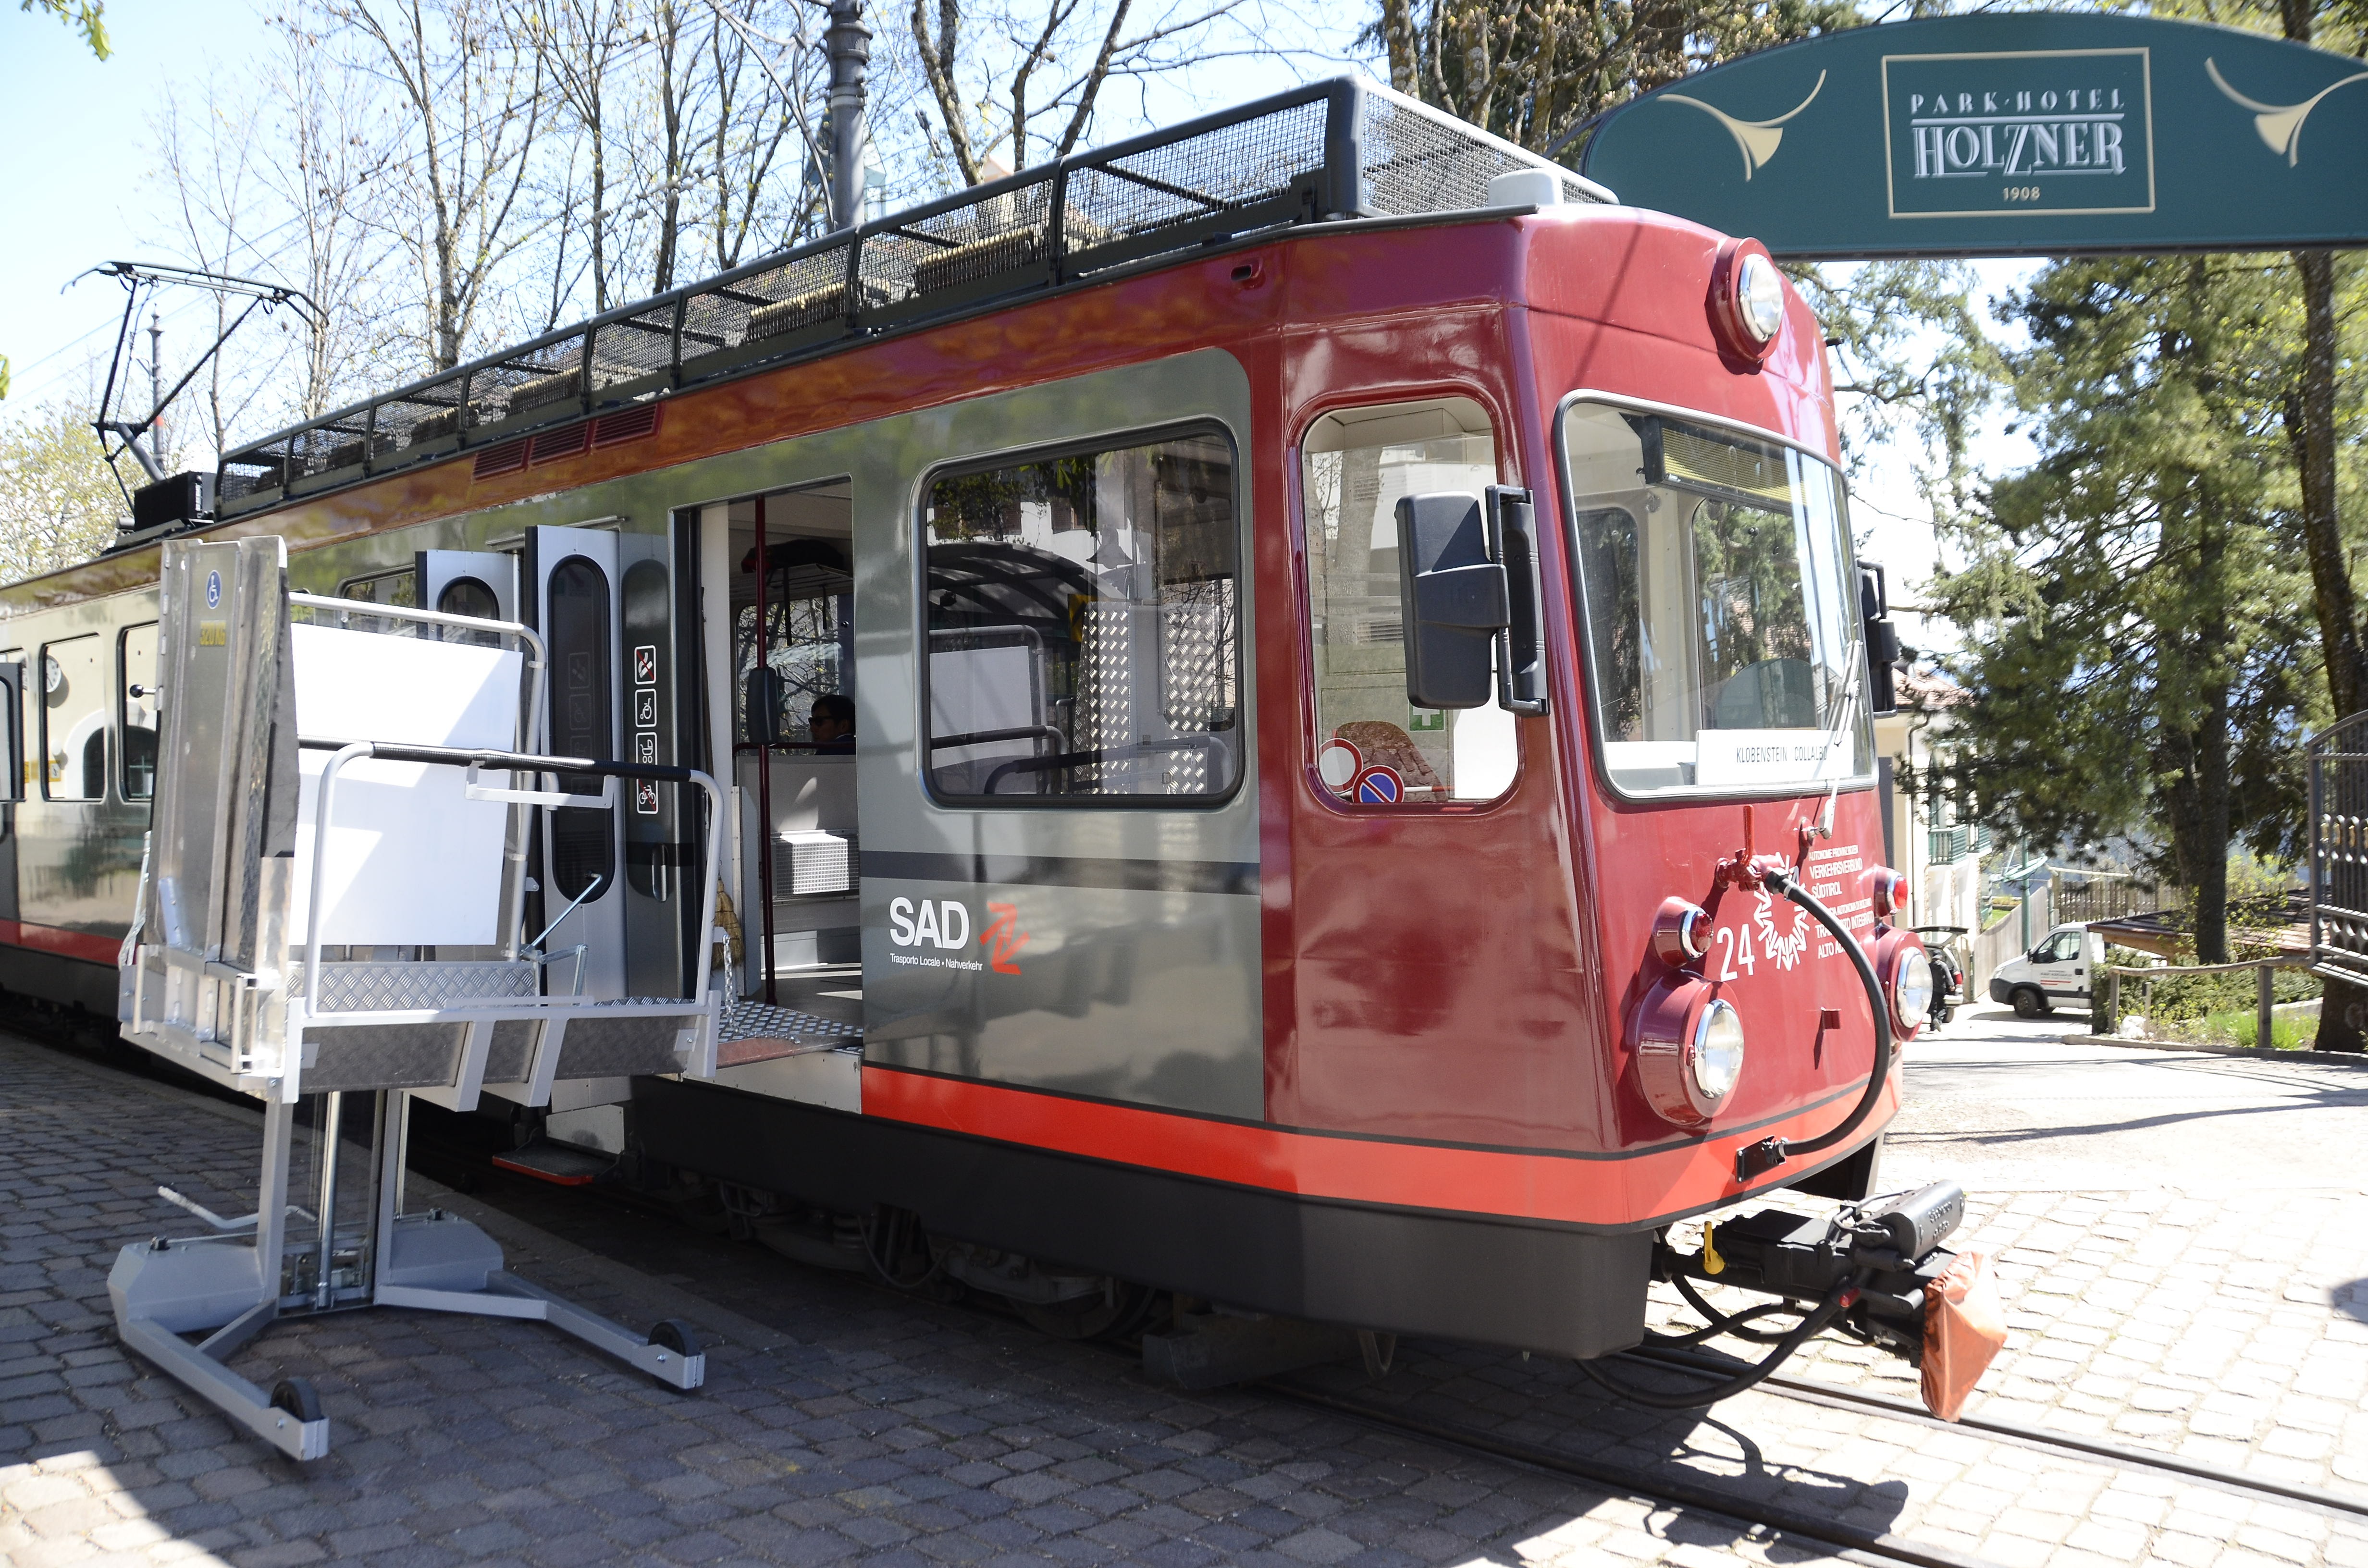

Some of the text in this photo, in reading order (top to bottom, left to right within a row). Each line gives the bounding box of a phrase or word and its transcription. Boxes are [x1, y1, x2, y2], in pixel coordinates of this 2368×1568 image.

[1912, 122, 2127, 179] HOLZNER
[2003, 186, 2041, 201] 1908
[1737, 746, 1828, 763] KLOBENSTEIN COLLALBO
[1809, 858, 1862, 879] VERKEHRSVERBUND
[1812, 881, 1843, 899] SÜDTIROL
[889, 897, 970, 950] SAD
[1716, 923, 1756, 982] 24
[1818, 942, 1835, 959] ALTO
[890, 953, 983, 971] Trasporto Locale Nahverkehr
